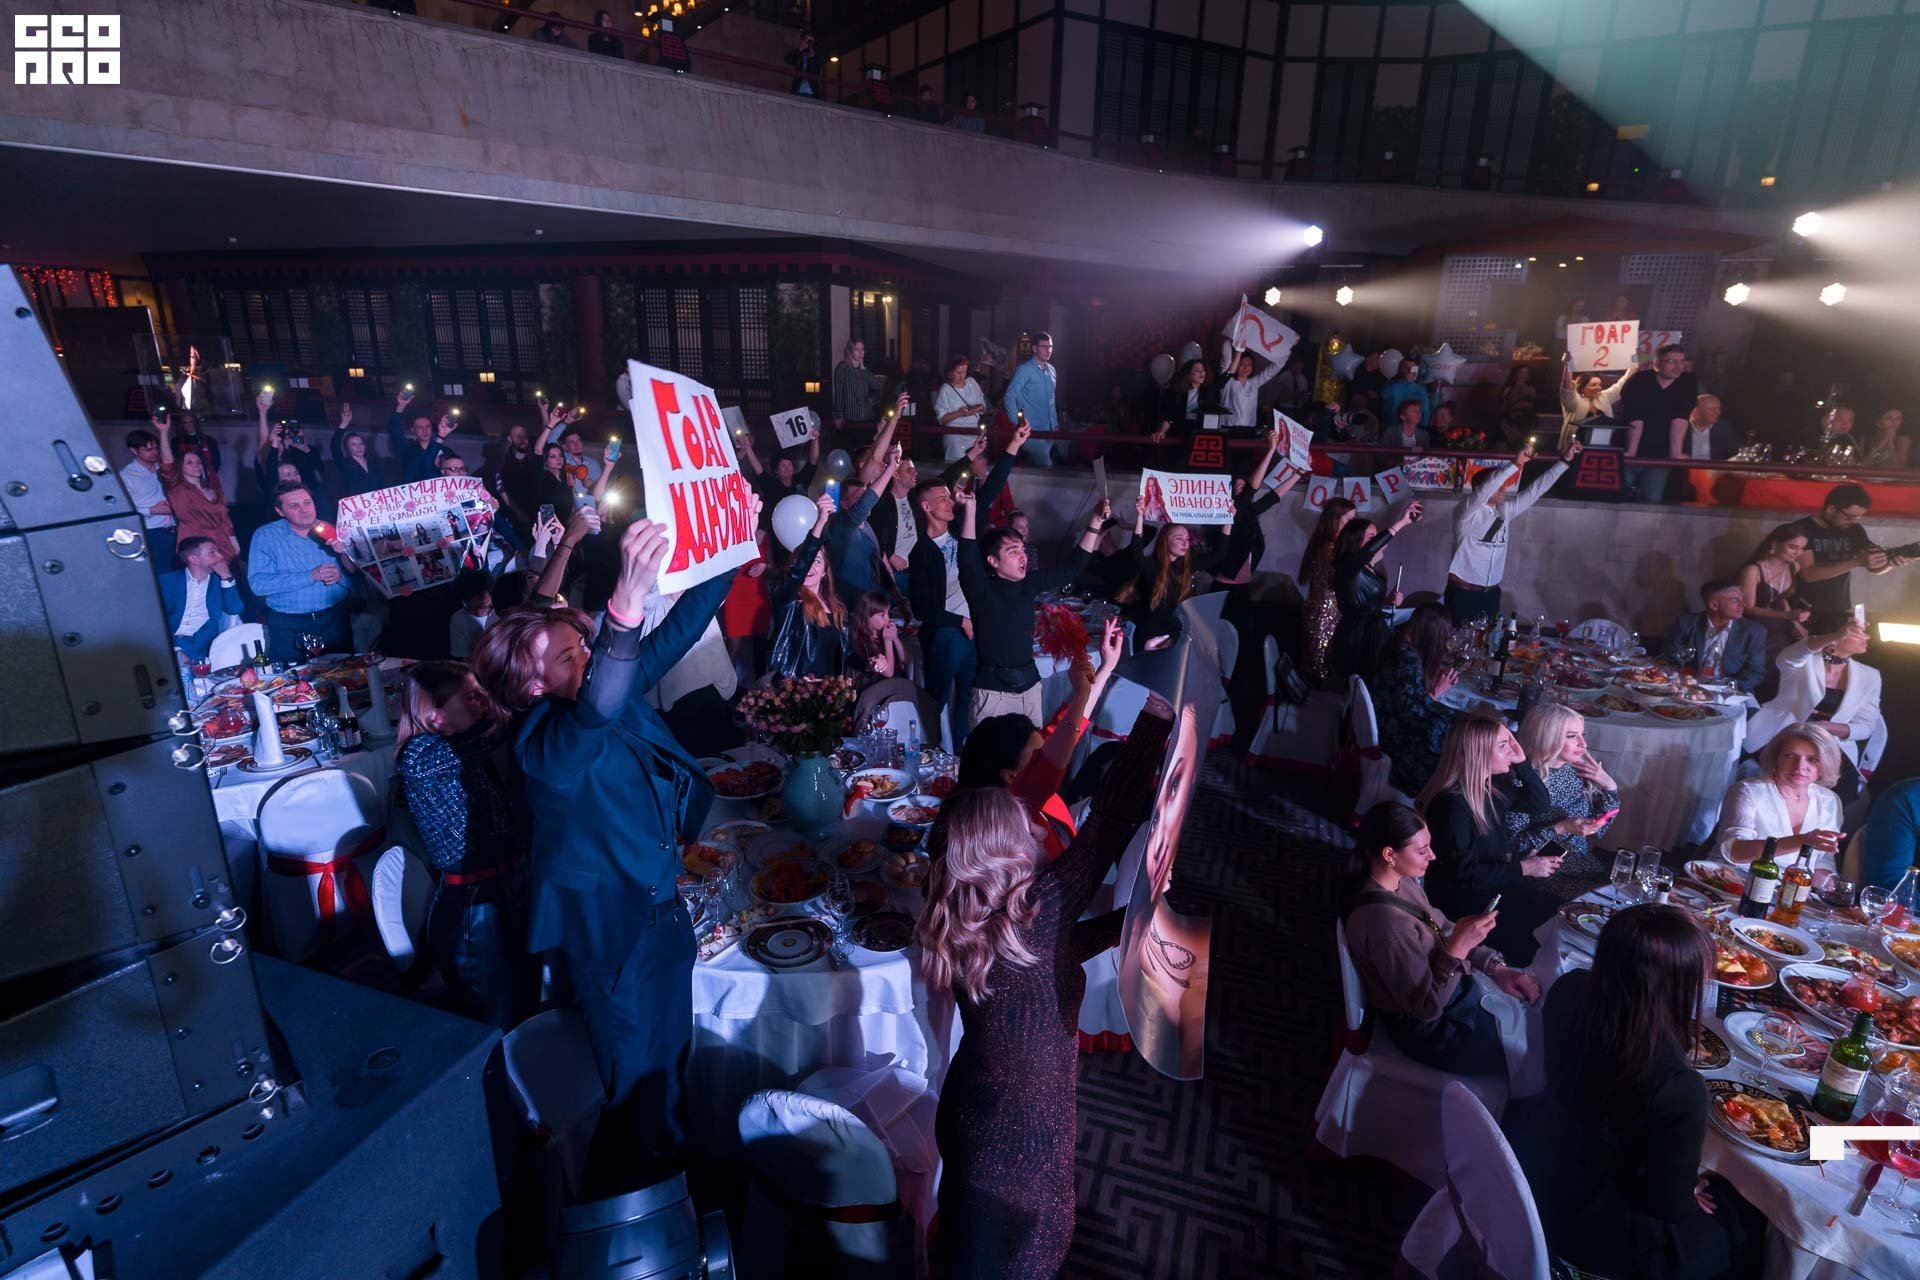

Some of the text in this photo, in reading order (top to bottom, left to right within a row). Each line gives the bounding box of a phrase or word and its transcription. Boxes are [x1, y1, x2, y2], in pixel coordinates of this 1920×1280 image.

[1581, 324, 1632, 345] ГОАР
[1593, 345, 1610, 368] 2
[651, 379, 729, 471] ГОАР
[785, 415, 808, 438] 16
[1168, 478, 1228, 496] ЭЛИНА
[1169, 496, 1230, 509] ИВАНОВА
